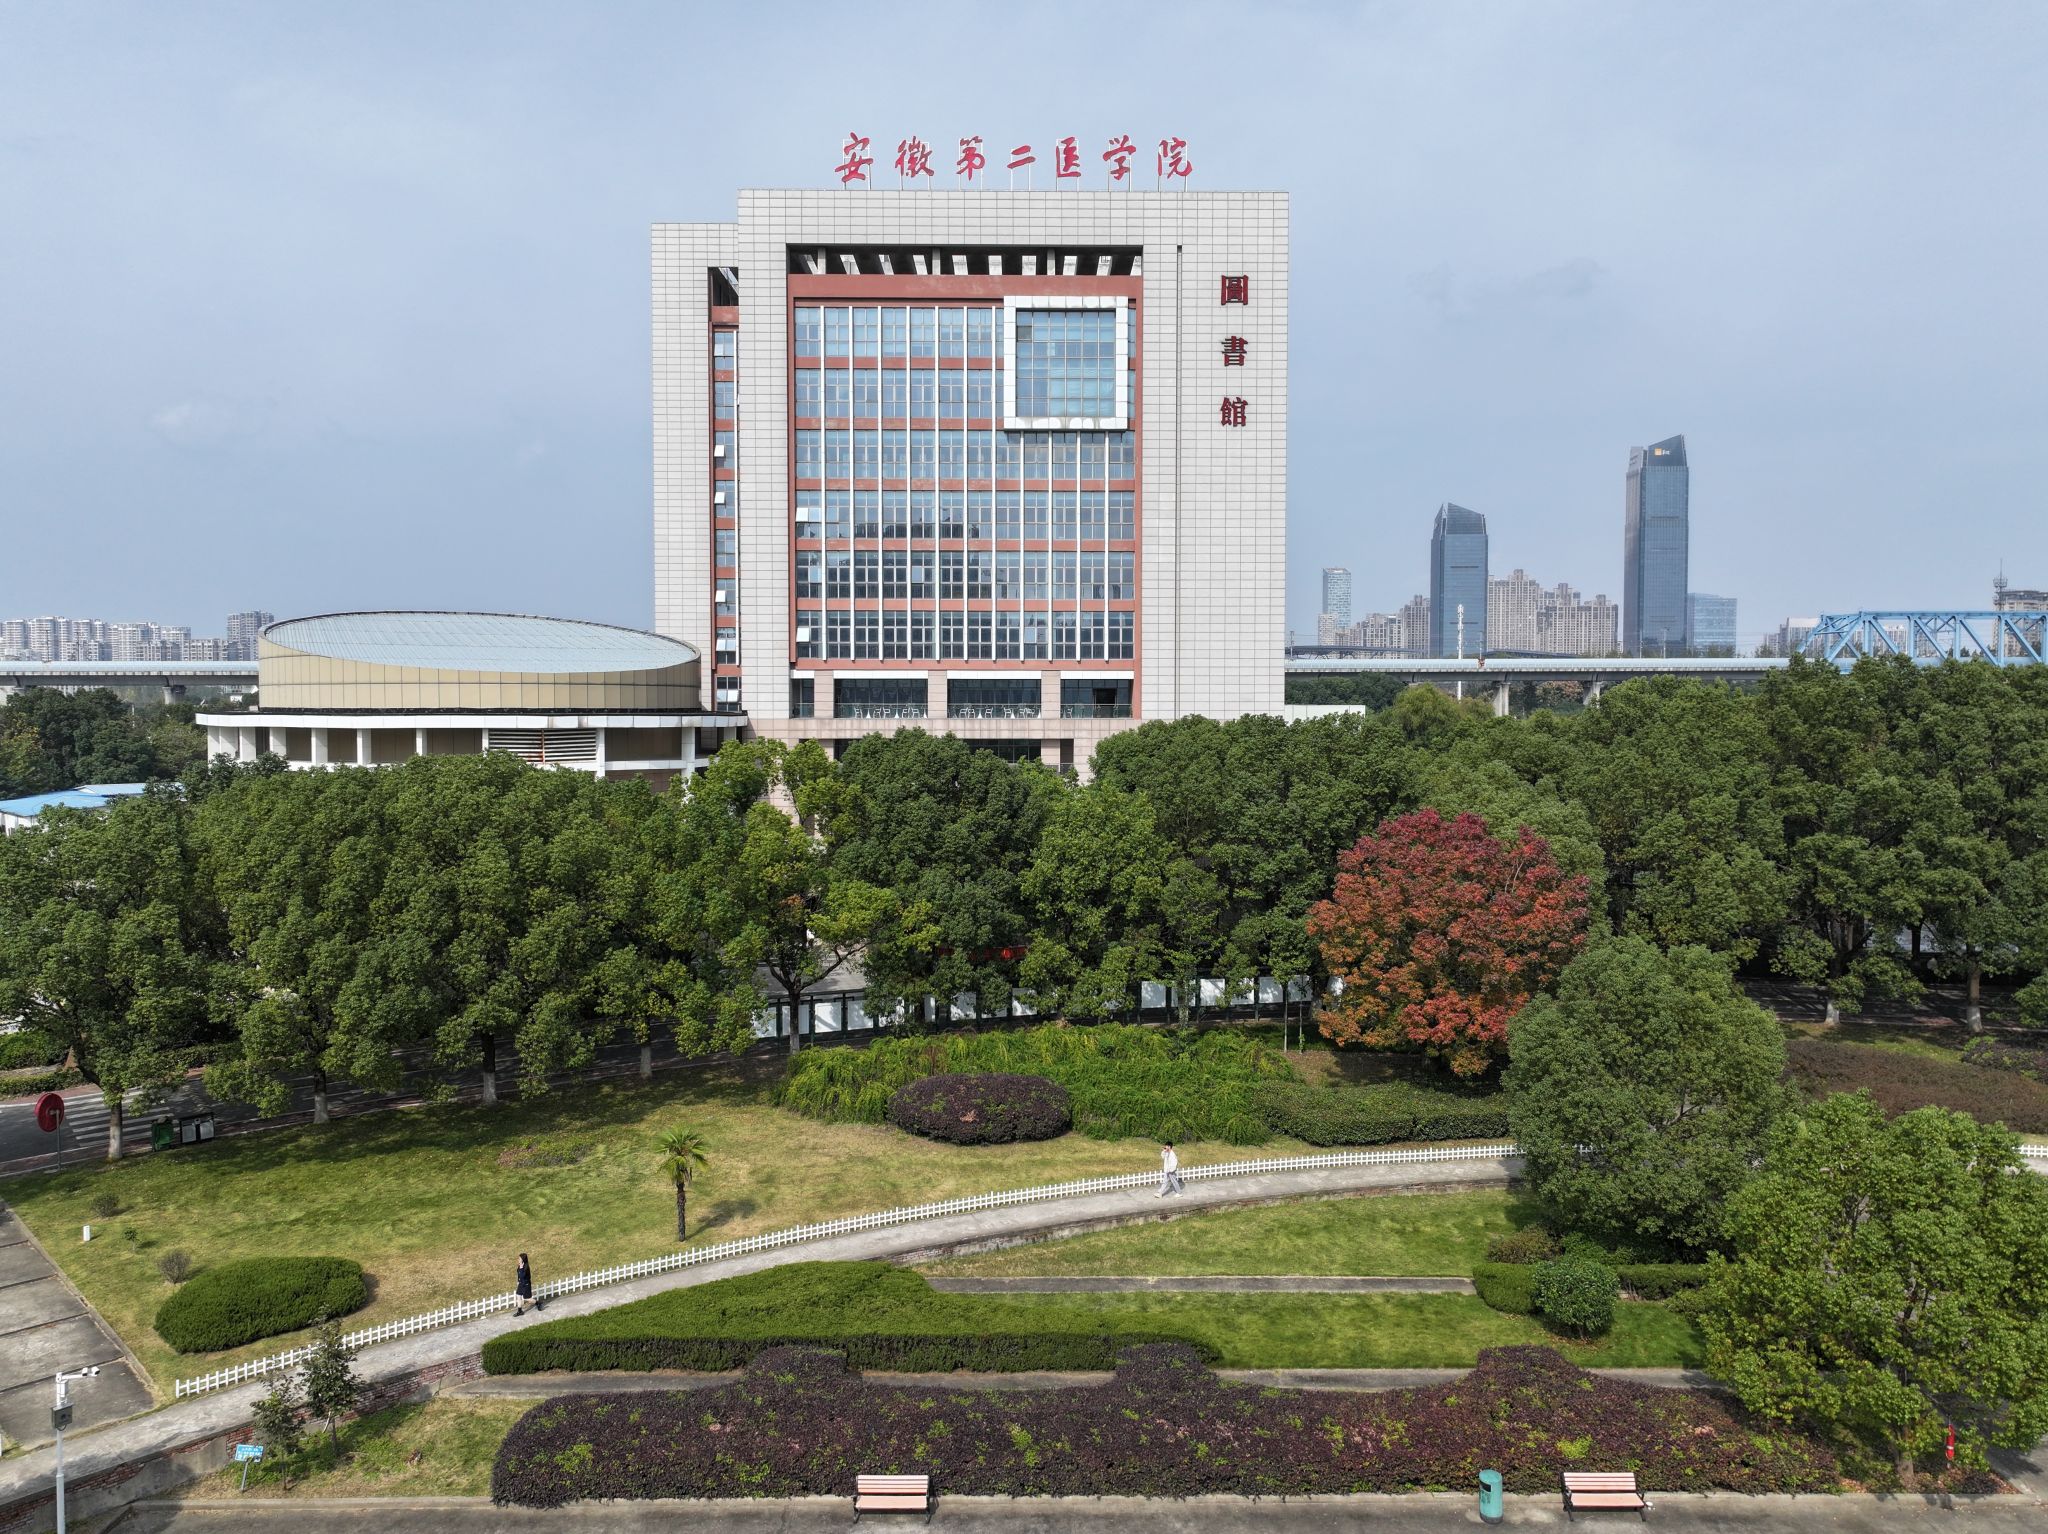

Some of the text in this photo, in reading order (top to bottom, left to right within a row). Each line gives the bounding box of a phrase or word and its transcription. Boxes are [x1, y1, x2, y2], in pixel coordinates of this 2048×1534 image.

[834, 131, 1193, 183] 安徽第二医学院
[1220, 274, 1249, 427] 圖書館
